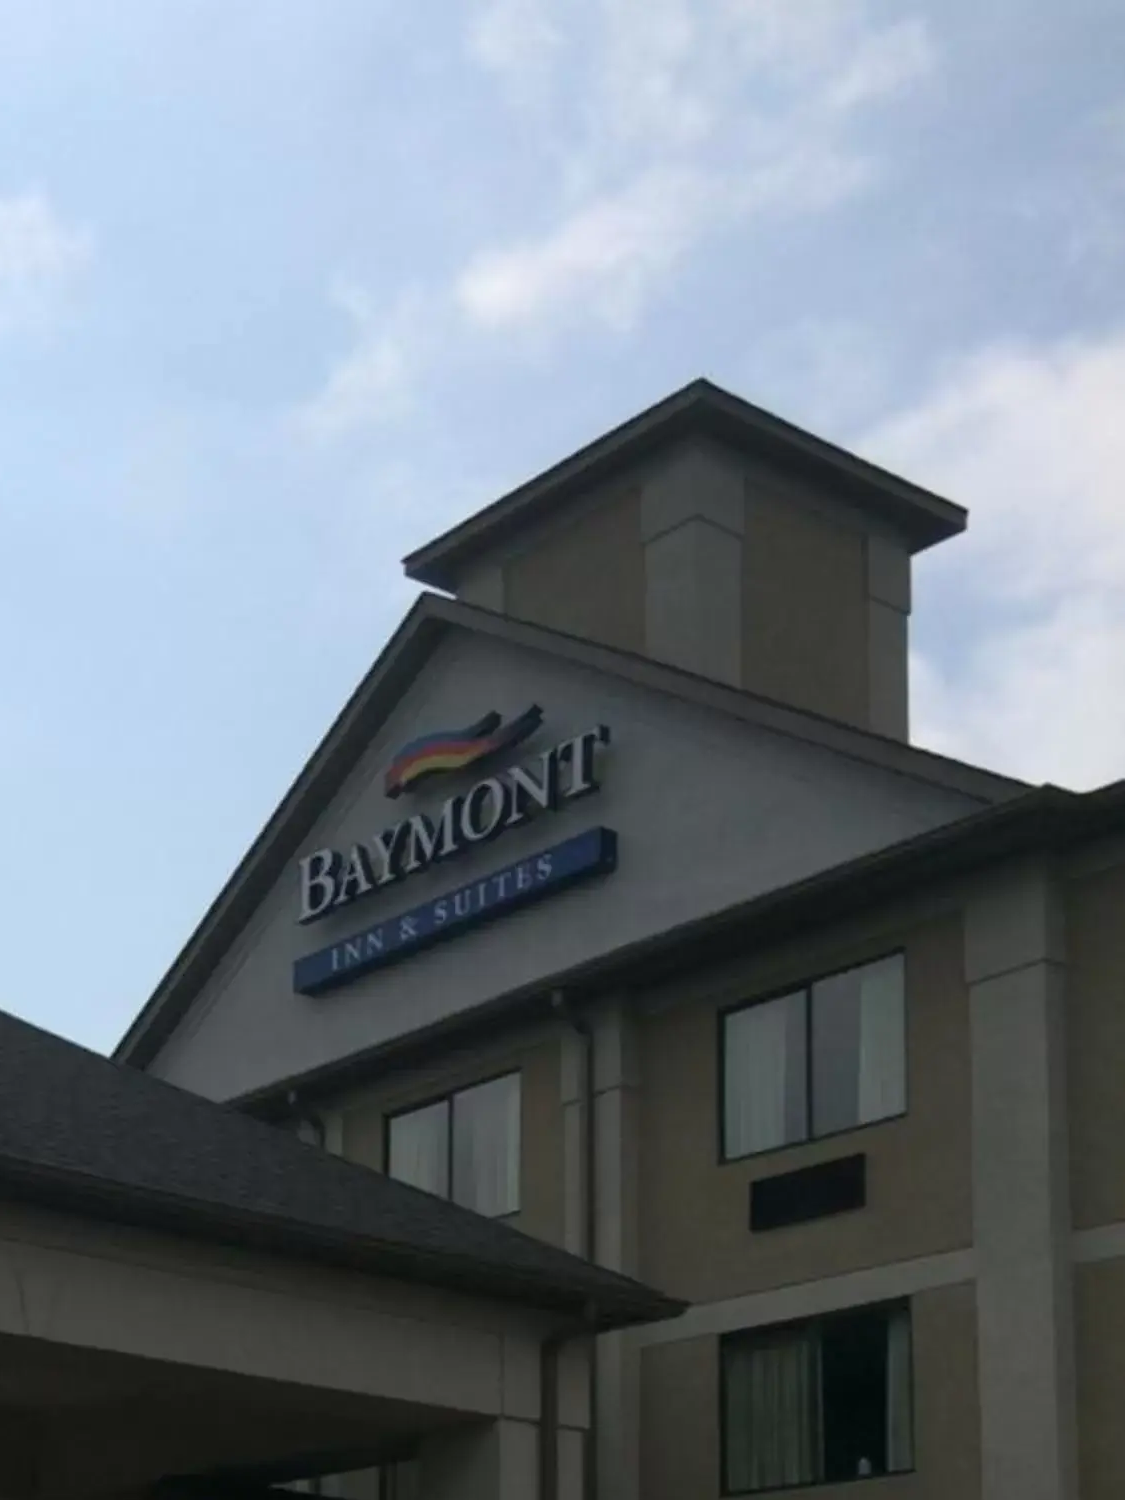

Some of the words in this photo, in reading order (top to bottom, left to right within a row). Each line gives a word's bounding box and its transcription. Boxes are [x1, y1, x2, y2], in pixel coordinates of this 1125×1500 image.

[297, 726, 609, 925] BAYMONT
[331, 929, 384, 971] INN
[399, 915, 419, 942] &
[434, 853, 553, 925] SUITES
